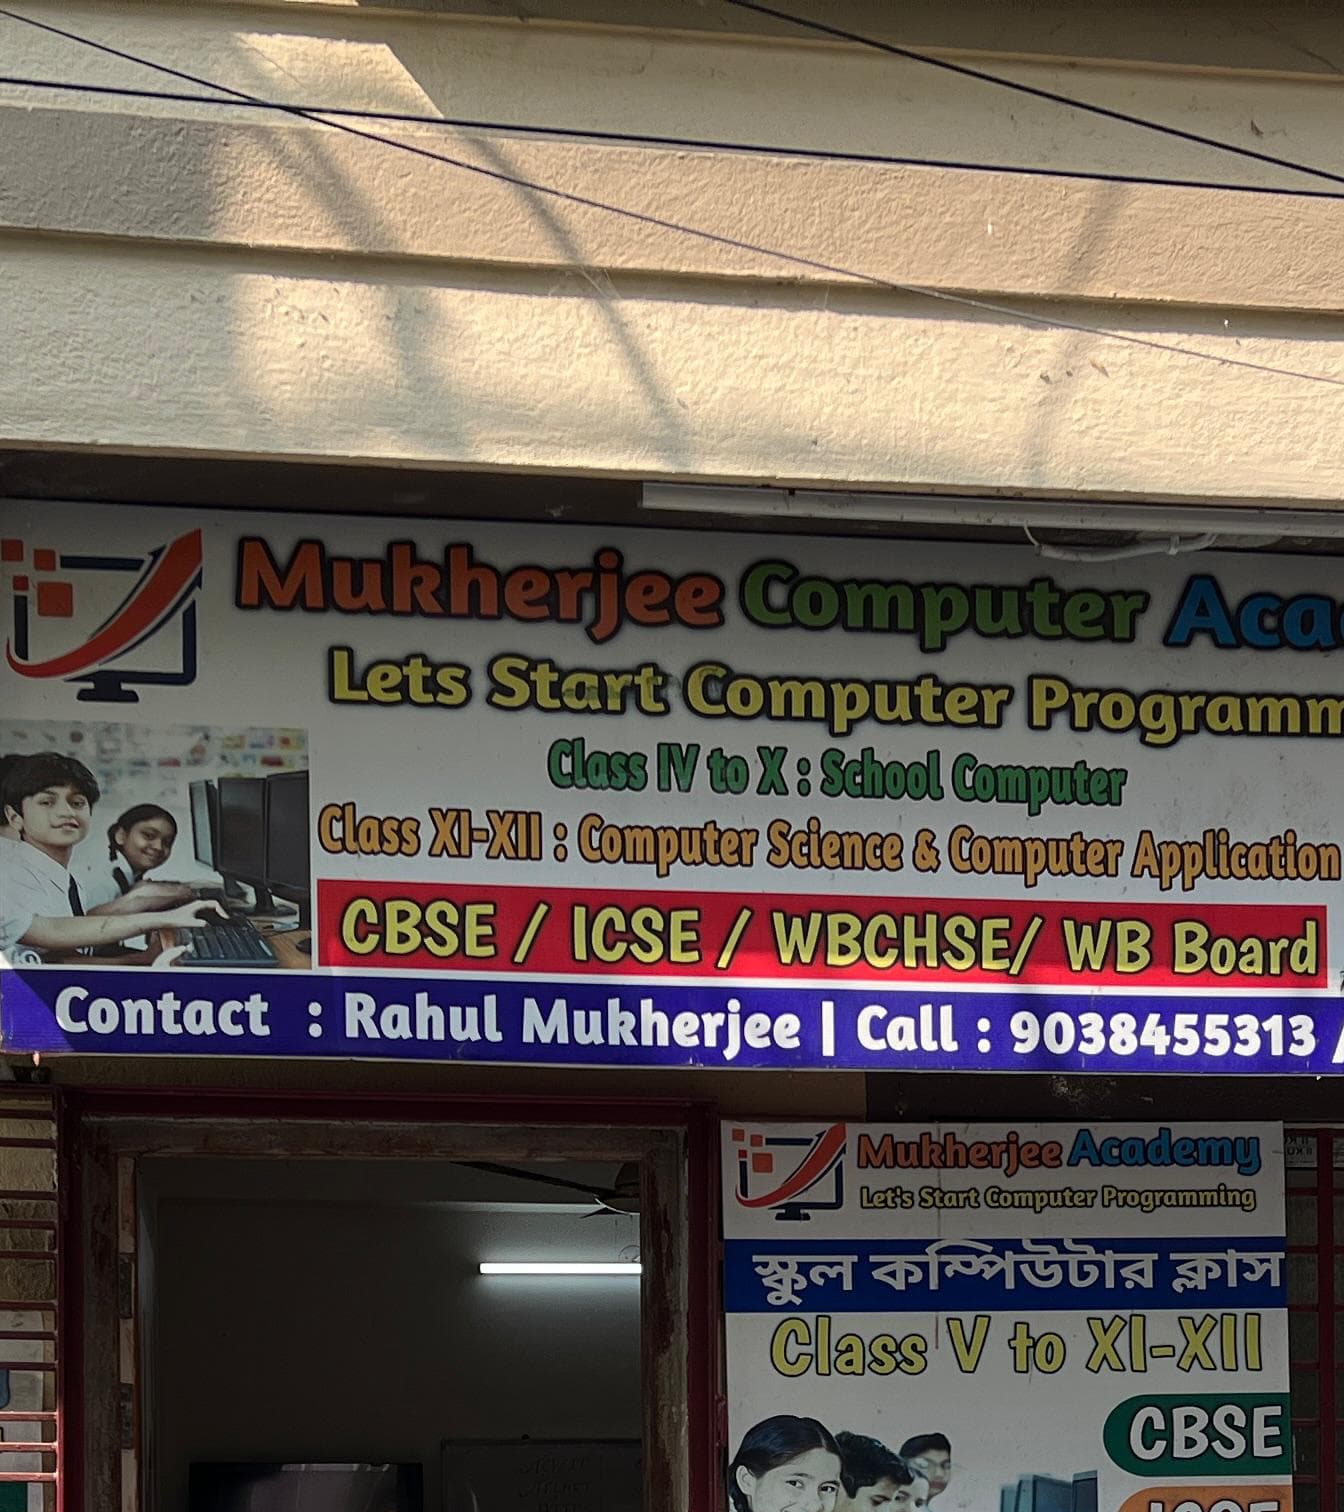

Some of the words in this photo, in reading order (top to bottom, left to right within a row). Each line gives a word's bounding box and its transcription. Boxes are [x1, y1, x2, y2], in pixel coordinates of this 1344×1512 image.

[236, 539, 722, 642] Mukherjee
[739, 560, 1148, 651] Computer
[328, 646, 470, 709] Lets
[486, 653, 666, 715] Start
[684, 663, 1008, 735] Computer
[547, 738, 648, 795] Class
[657, 742, 697, 795] IV
[707, 747, 749, 796] to
[821, 748, 942, 802] School
[951, 753, 1128, 816] Computer
[318, 804, 419, 859] Class
[429, 808, 542, 862] XI-XII
[578, 814, 757, 877] Computer
[767, 816, 902, 873] Science
[913, 833, 941, 874] &
[948, 826, 1124, 889] Computer
[1131, 831, 1342, 891] Application
[340, 896, 498, 961] CBSE
[513, 902, 552, 965] /
[571, 905, 703, 967] ICSE
[716, 907, 753, 970] /
[1063, 917, 1152, 978] WB
[1172, 919, 1319, 980] Board
[56, 985, 269, 1040] Contact
[344, 987, 502, 1044] Rahul
[521, 995, 802, 1070] Mukherjee
[857, 1005, 958, 1055] Call
[1013, 1010, 1317, 1058] 9038455313
[857, 1131, 1062, 1176] Mukherjee
[1067, 1127, 1262, 1175] Academy
[860, 1185, 914, 1209] Let's
[918, 1186, 979, 1209] Start
[985, 1185, 1096, 1213] Computer
[1101, 1184, 1256, 1213] Programming
[752, 1253, 858, 1306] স্কুল
[869, 1238, 1158, 1291] কম্পিউটার
[1169, 1250, 1285, 1293] ক্লাস
[770, 1315, 928, 1378] Class
[946, 1316, 991, 1374] V
[1008, 1321, 1066, 1374] to
[1086, 1314, 1262, 1373] XI-XII
[1130, 1405, 1283, 1460] CBSE
